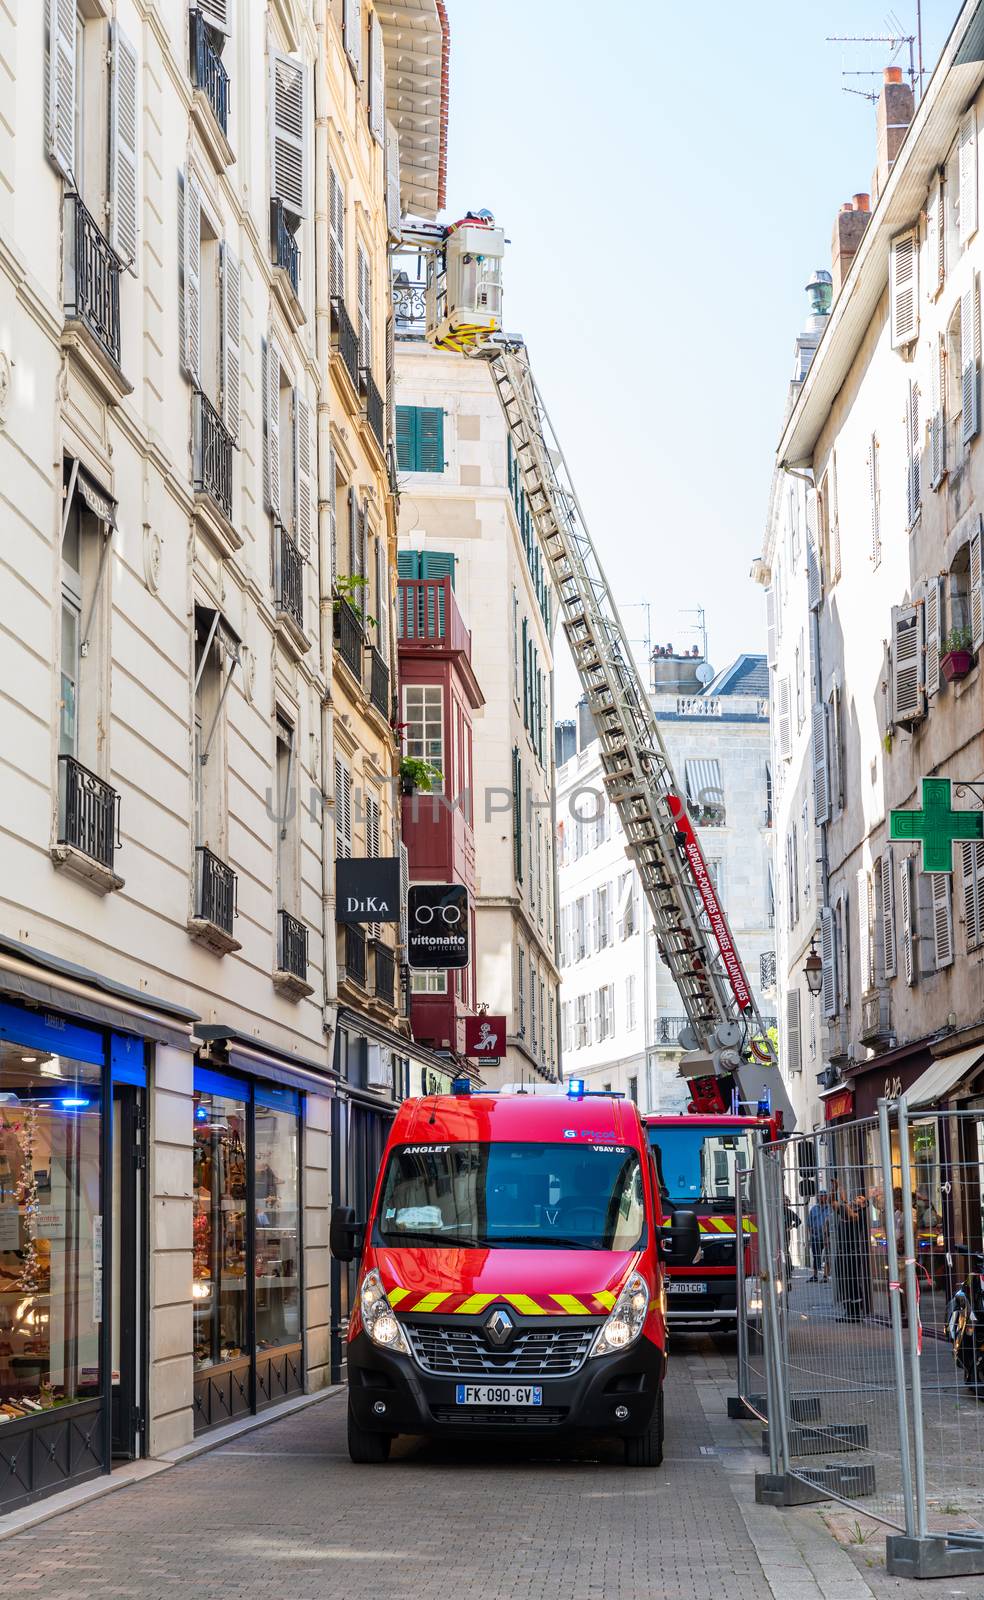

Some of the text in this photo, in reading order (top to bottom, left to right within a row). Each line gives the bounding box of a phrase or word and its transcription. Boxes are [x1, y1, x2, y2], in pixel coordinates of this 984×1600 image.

[687, 843, 749, 1002] SAPEURS-POMPIERS PYRENEES ATLANTIQUES
[411, 935, 466, 945] vittonatto
[403, 1146, 451, 1154] ANGLET
[466, 1388, 531, 1403] FK-090-GV
